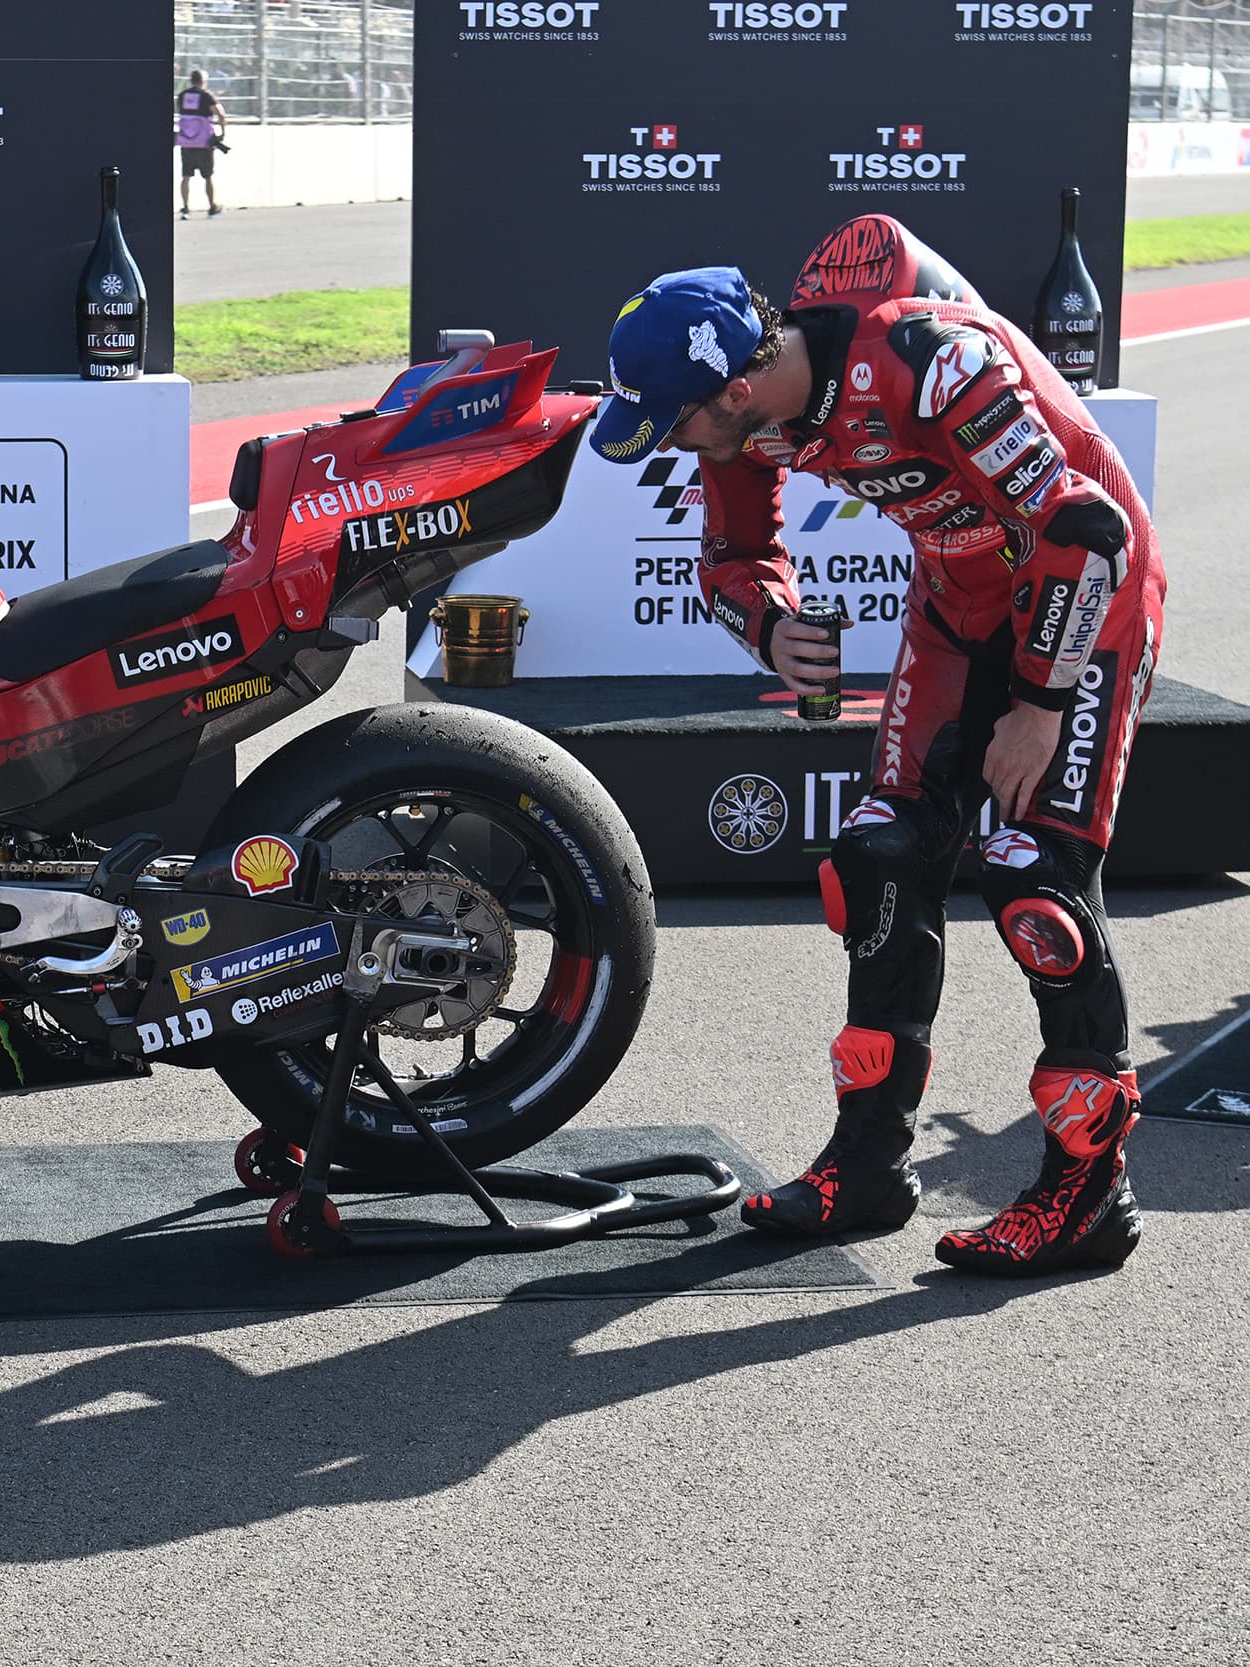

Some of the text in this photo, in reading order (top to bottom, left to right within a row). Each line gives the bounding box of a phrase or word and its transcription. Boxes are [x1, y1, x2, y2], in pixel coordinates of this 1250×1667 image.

[460, 2, 599, 28] TISSOT
[709, 3, 847, 28] TISSOT
[955, 3, 1093, 28] TISSOT
[459, 32, 599, 41] SWISS WATCHES SINCE 1853
[708, 33, 847, 42] SWISS WATCHES SINCE 1853
[954, 33, 1092, 42] SWISS WATCHES SINCE 1853
[583, 154, 720, 178] TISSOT
[830, 154, 966, 178] TISSOT
[582, 183, 720, 192] SWISS WATCHES SINCE 1853
[828, 183, 966, 192] SWISS WATCHES SINCE 1853
[104, 302, 133, 315] GENIO
[1066, 319, 1094, 332] GENIO
[104, 334, 135, 347] GENIO
[1065, 350, 1095, 364] GENIO
[457, 397, 500, 420] TIM
[811, 378, 837, 425] Lenovo
[995, 421, 1031, 461] riello
[1006, 448, 1054, 495] elica
[289, 479, 415, 524] riello ups
[346, 499, 472, 552] FLEX-BOX
[827, 554, 912, 584] GRAN
[634, 596, 674, 625] OF
[714, 594, 745, 631] Lenovo
[1033, 584, 1068, 653] Lenovo
[1060, 577, 1105, 662] UnipolSai
[119, 632, 232, 677] Lenovo
[1051, 664, 1103, 813] Lenovo
[545, 819, 602, 898] MICHELIN
[165, 912, 207, 936] WD-40
[222, 937, 322, 980] MICHELIN
[258, 973, 344, 1013] Reflexalle
